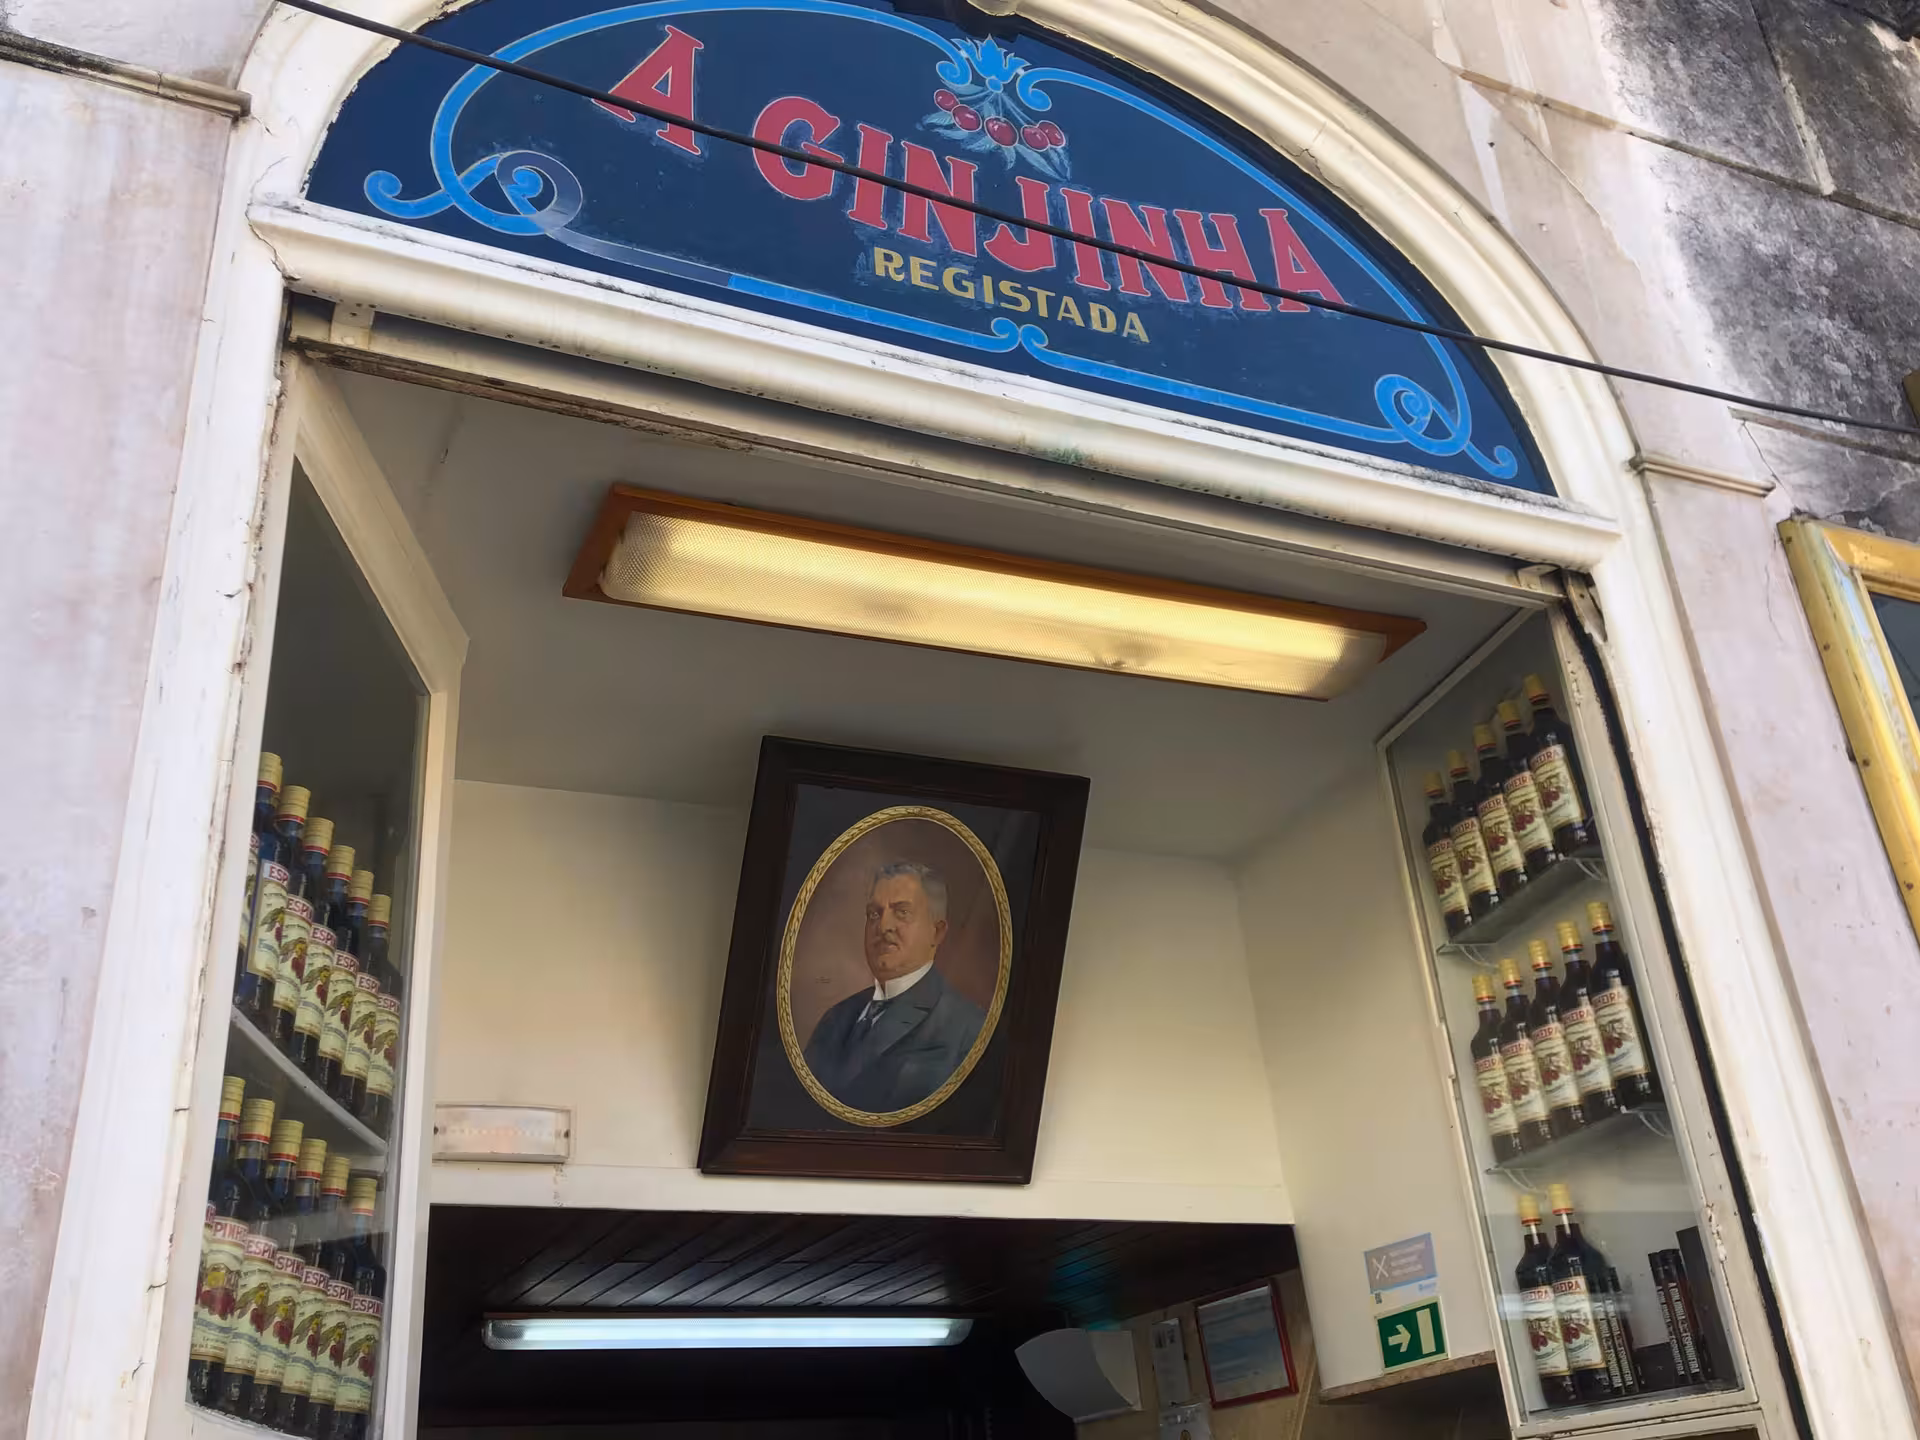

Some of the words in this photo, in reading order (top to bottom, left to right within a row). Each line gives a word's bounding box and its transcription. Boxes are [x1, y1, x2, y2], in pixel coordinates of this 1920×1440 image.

[591, 24, 704, 157] A
[750, 96, 1347, 313] GINJINHA
[873, 246, 1150, 344] REGISTADA
